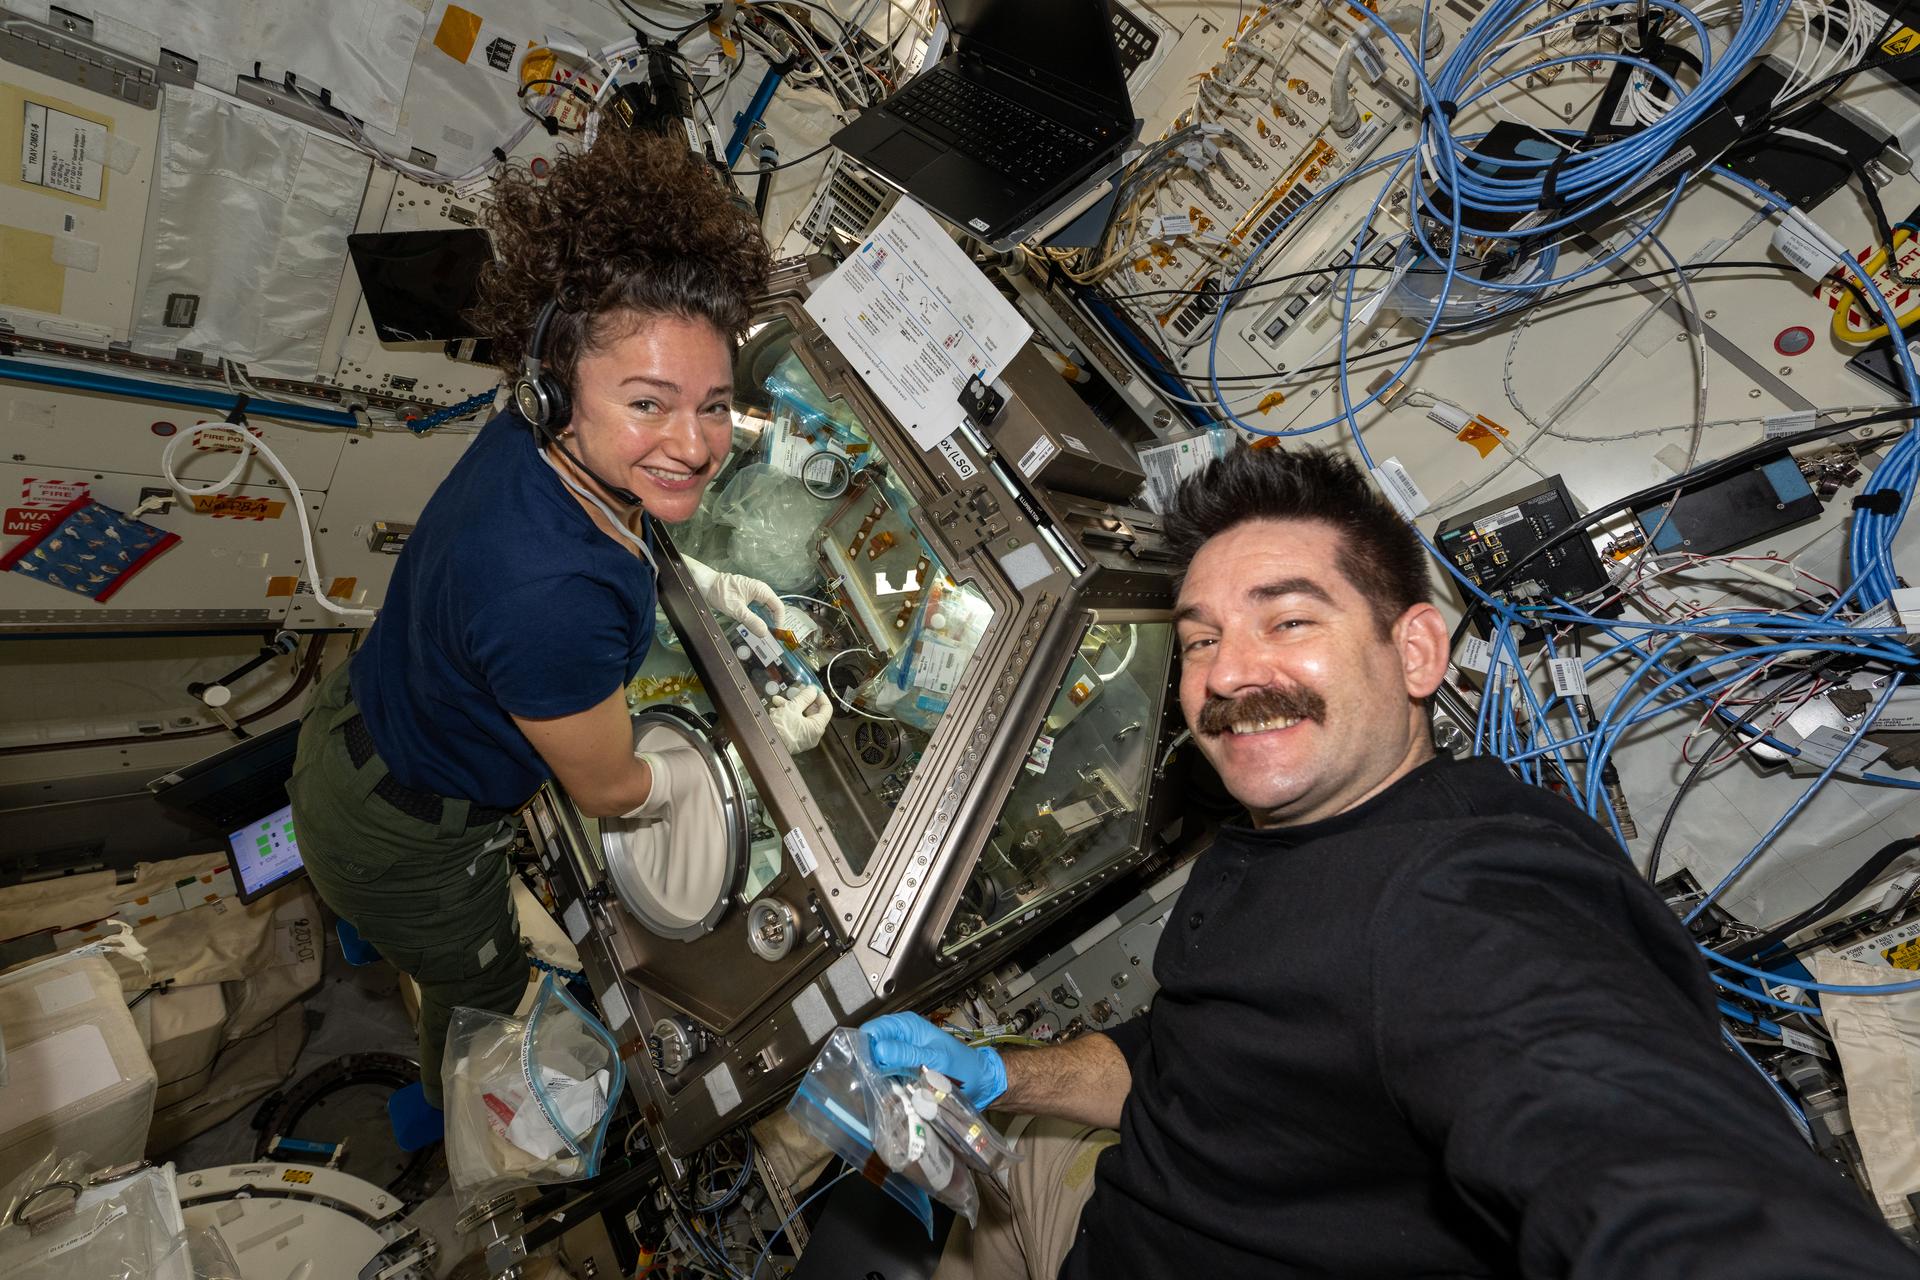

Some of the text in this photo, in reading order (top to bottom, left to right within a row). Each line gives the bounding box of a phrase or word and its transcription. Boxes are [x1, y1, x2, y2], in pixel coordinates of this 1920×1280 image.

[558, 105, 571, 123] FIRE
[939, 438, 973, 479] ox (LSG)
[7, 522, 43, 531] MIS
[1880, 939, 1894, 947] TEST
[1845, 944, 1865, 955] POWER
[1852, 950, 1863, 958] OUT
[520, 1047, 530, 1067] OUTER
[527, 1080, 541, 1104] BEFORE
[537, 1102, 554, 1125] PLACING
